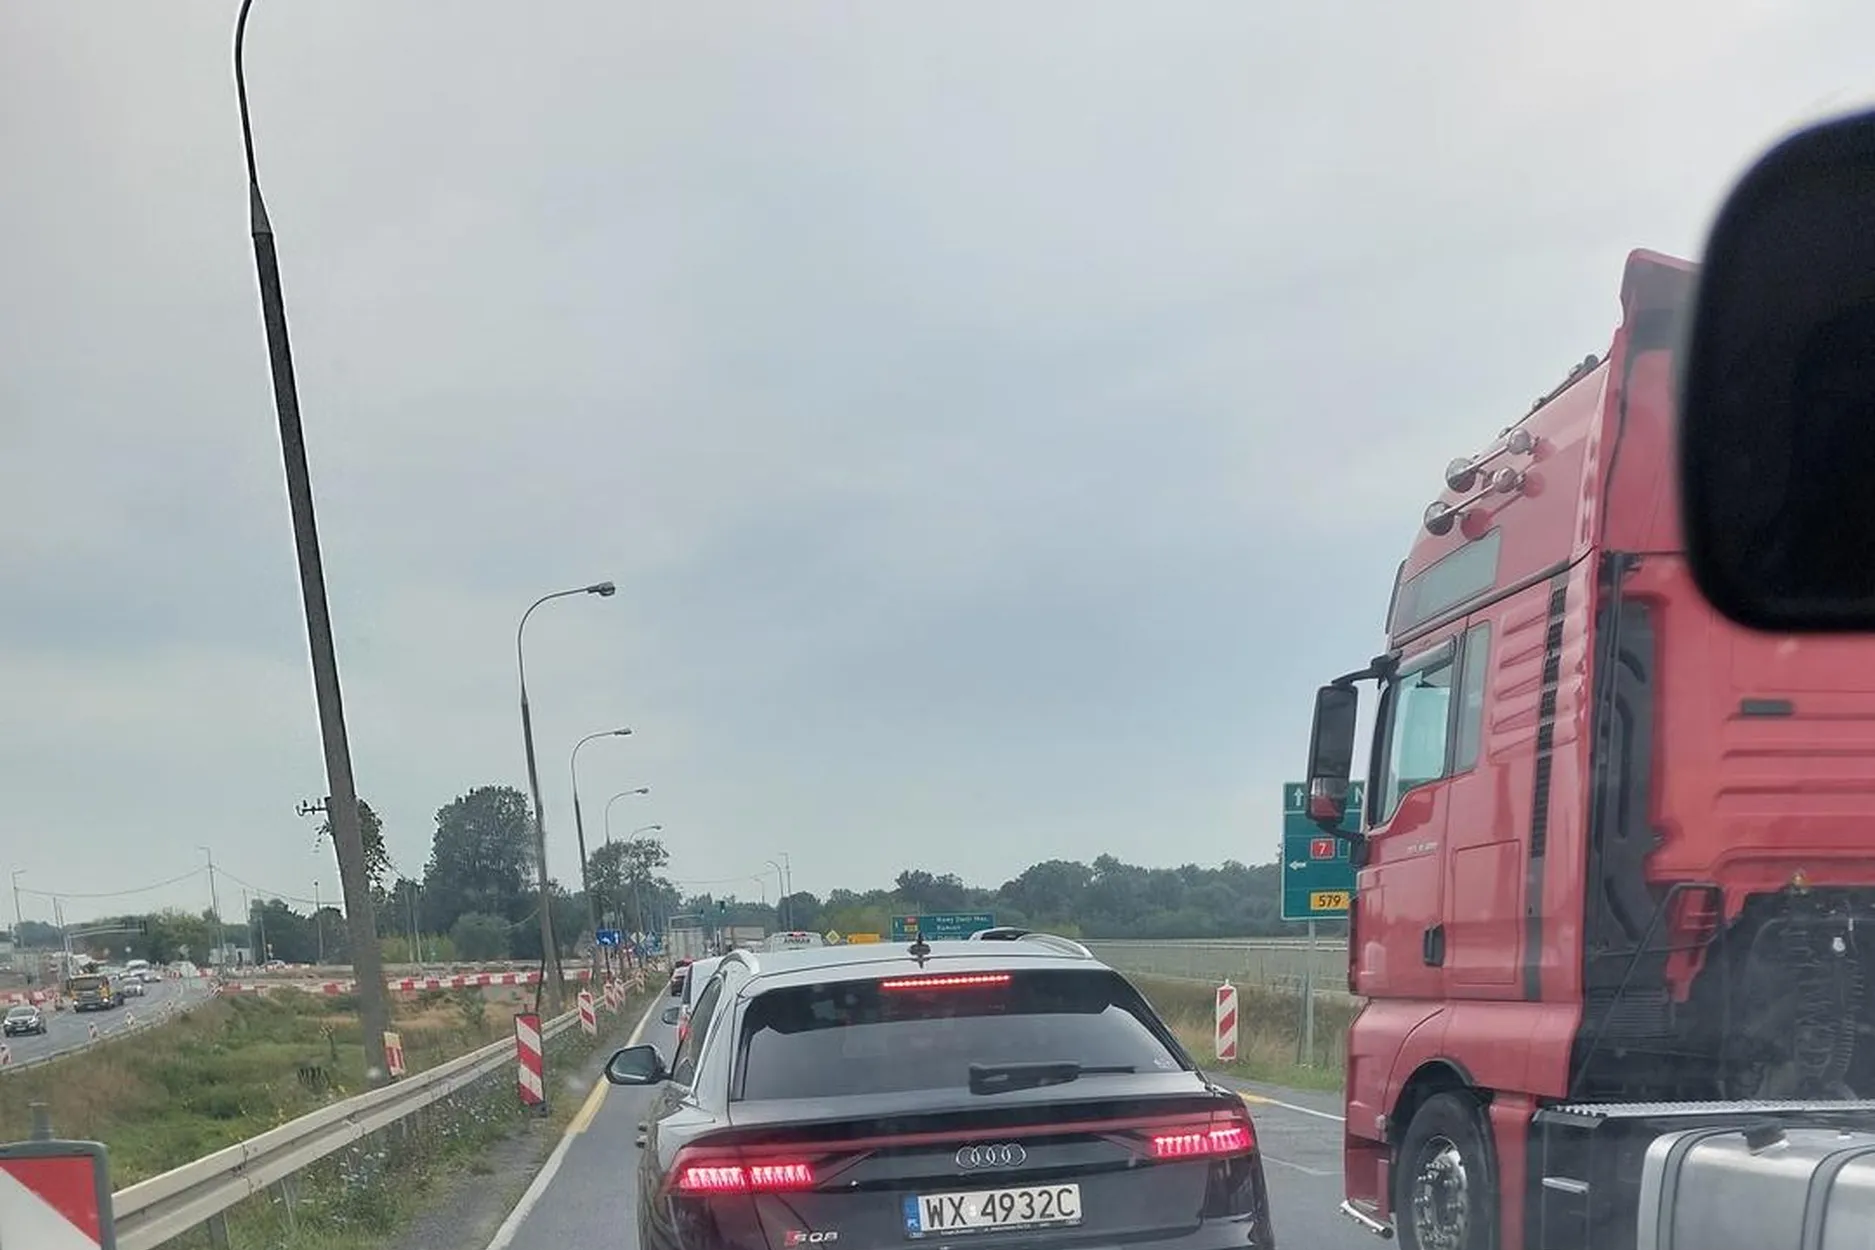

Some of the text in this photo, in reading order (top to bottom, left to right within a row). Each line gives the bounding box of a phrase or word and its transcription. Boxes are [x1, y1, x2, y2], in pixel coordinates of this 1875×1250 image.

[1318, 843, 1327, 855] 7
[1318, 894, 1342, 908] 579
[926, 1188, 1075, 1228] WX 4932C
